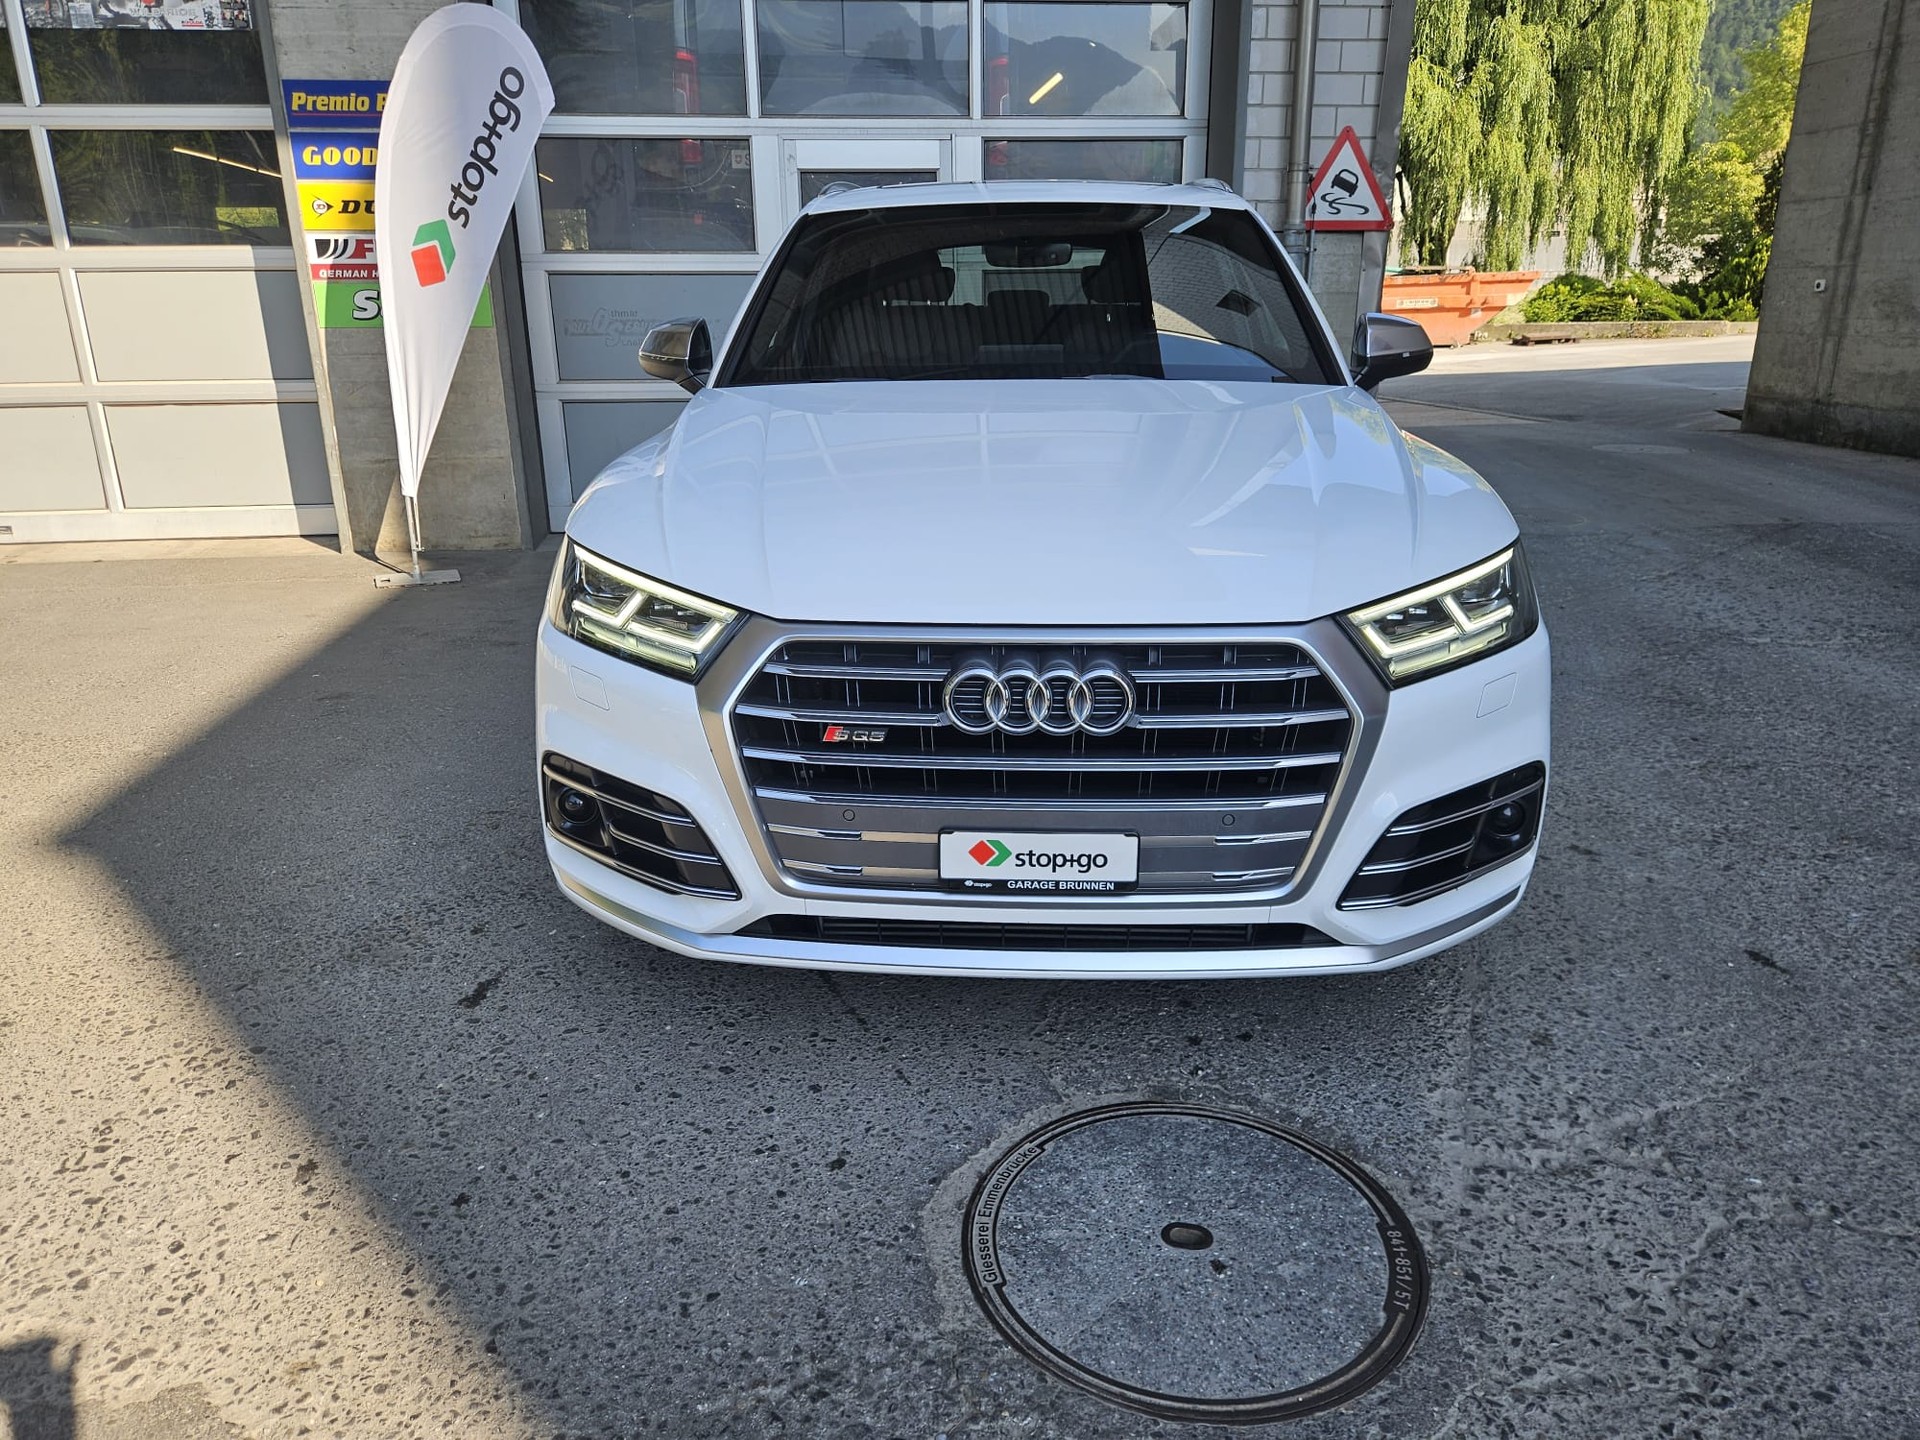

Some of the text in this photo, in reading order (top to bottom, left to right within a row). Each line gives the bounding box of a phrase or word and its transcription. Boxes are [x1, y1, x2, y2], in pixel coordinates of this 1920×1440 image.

[291, 92, 370, 112] Premio
[302, 146, 378, 166] GOOD
[448, 66, 525, 229] stop+go
[319, 269, 368, 278] GERMAN
[352, 289, 383, 321] S
[830, 729, 886, 742] SQ5
[1014, 850, 1108, 873] stop+go
[1007, 880, 1115, 891] GARAGE BRUNNEN
[976, 1146, 1037, 1283] Giesserei Emmenbrücke
